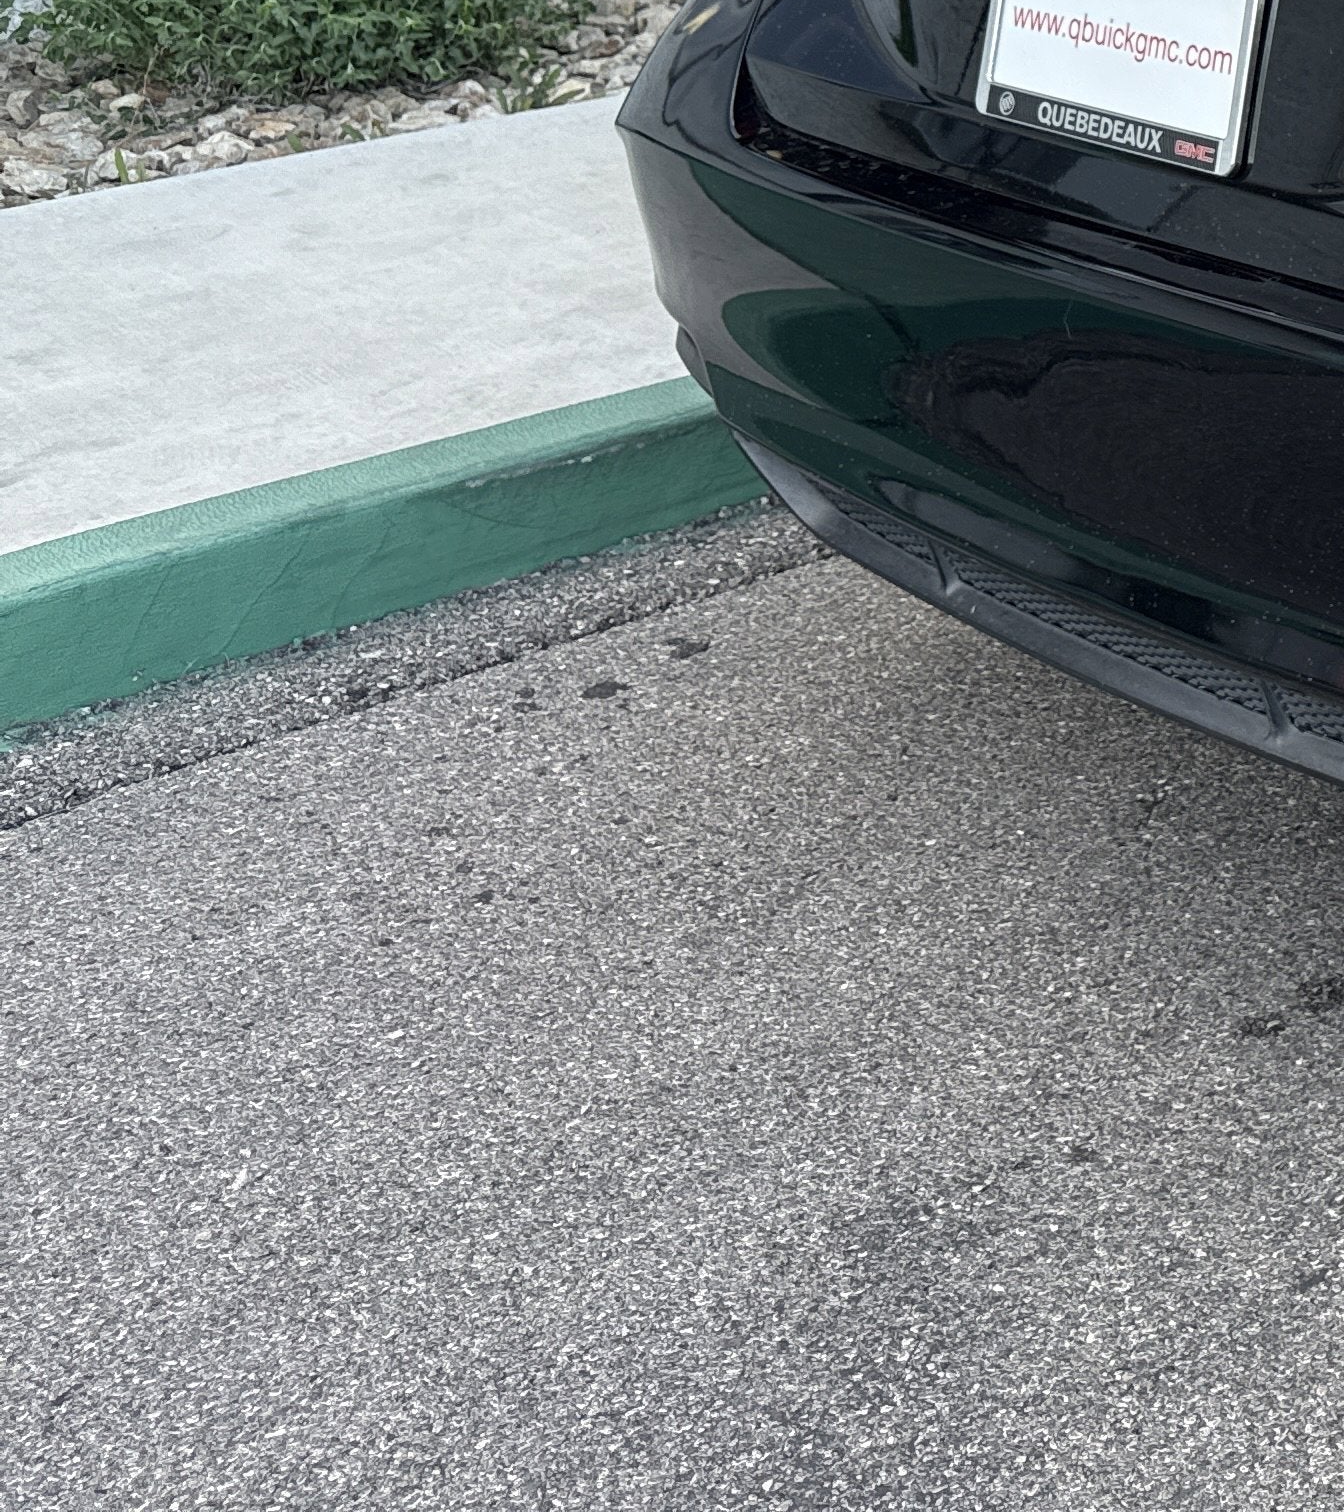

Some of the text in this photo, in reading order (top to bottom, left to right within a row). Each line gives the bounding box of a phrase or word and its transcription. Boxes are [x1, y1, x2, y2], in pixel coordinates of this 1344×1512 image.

[1013, 5, 1233, 75] www.qbuickgmc.com
[1038, 101, 1215, 164] QUEBEDEAUX GMC
